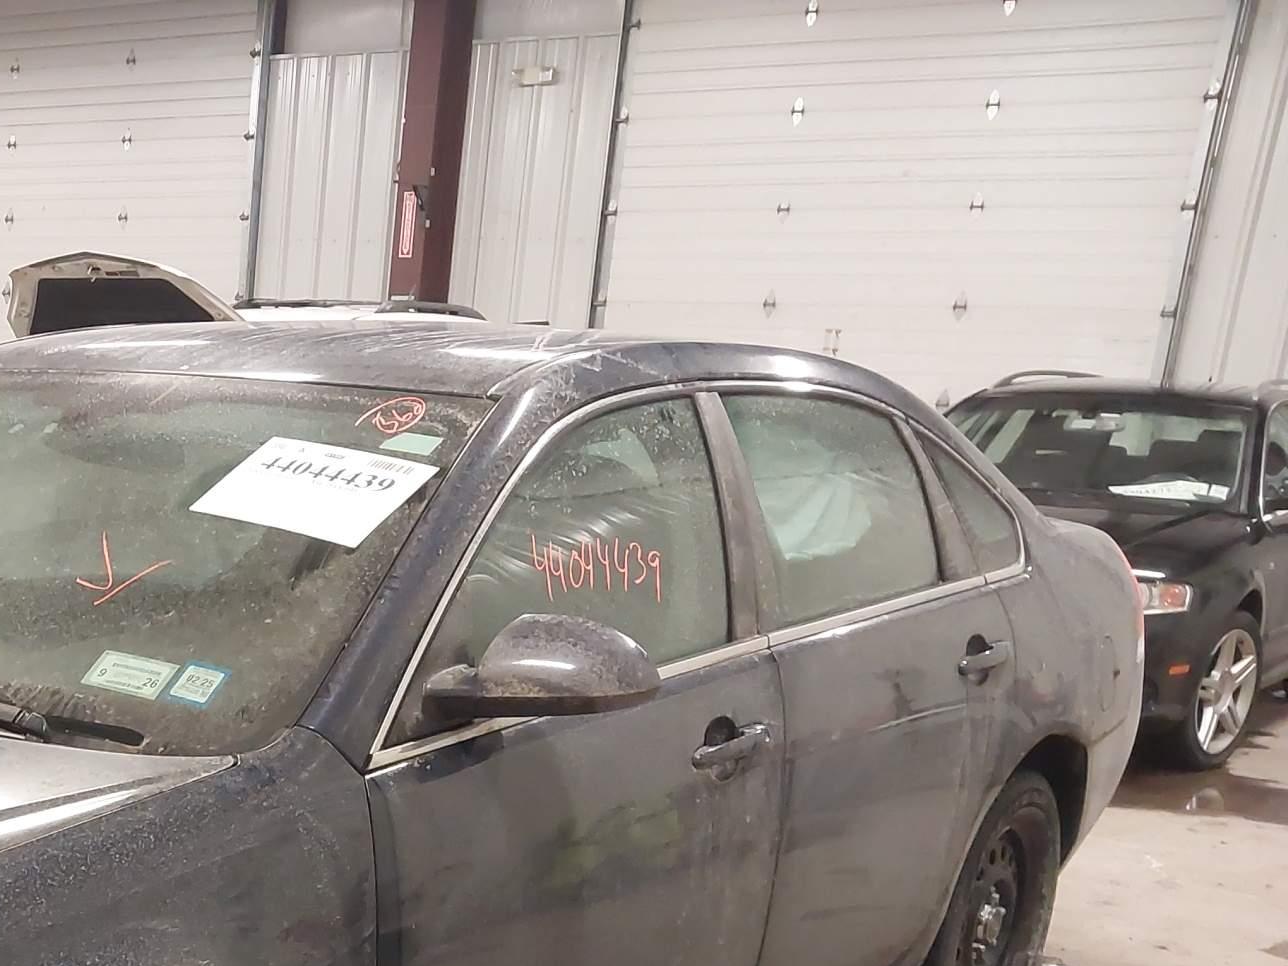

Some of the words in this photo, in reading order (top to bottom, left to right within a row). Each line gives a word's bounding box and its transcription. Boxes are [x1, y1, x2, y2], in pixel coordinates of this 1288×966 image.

[261, 456, 396, 492] 44044439
[531, 533, 661, 604] 44044439
[97, 667, 108, 678] 9
[142, 677, 160, 689] 26
